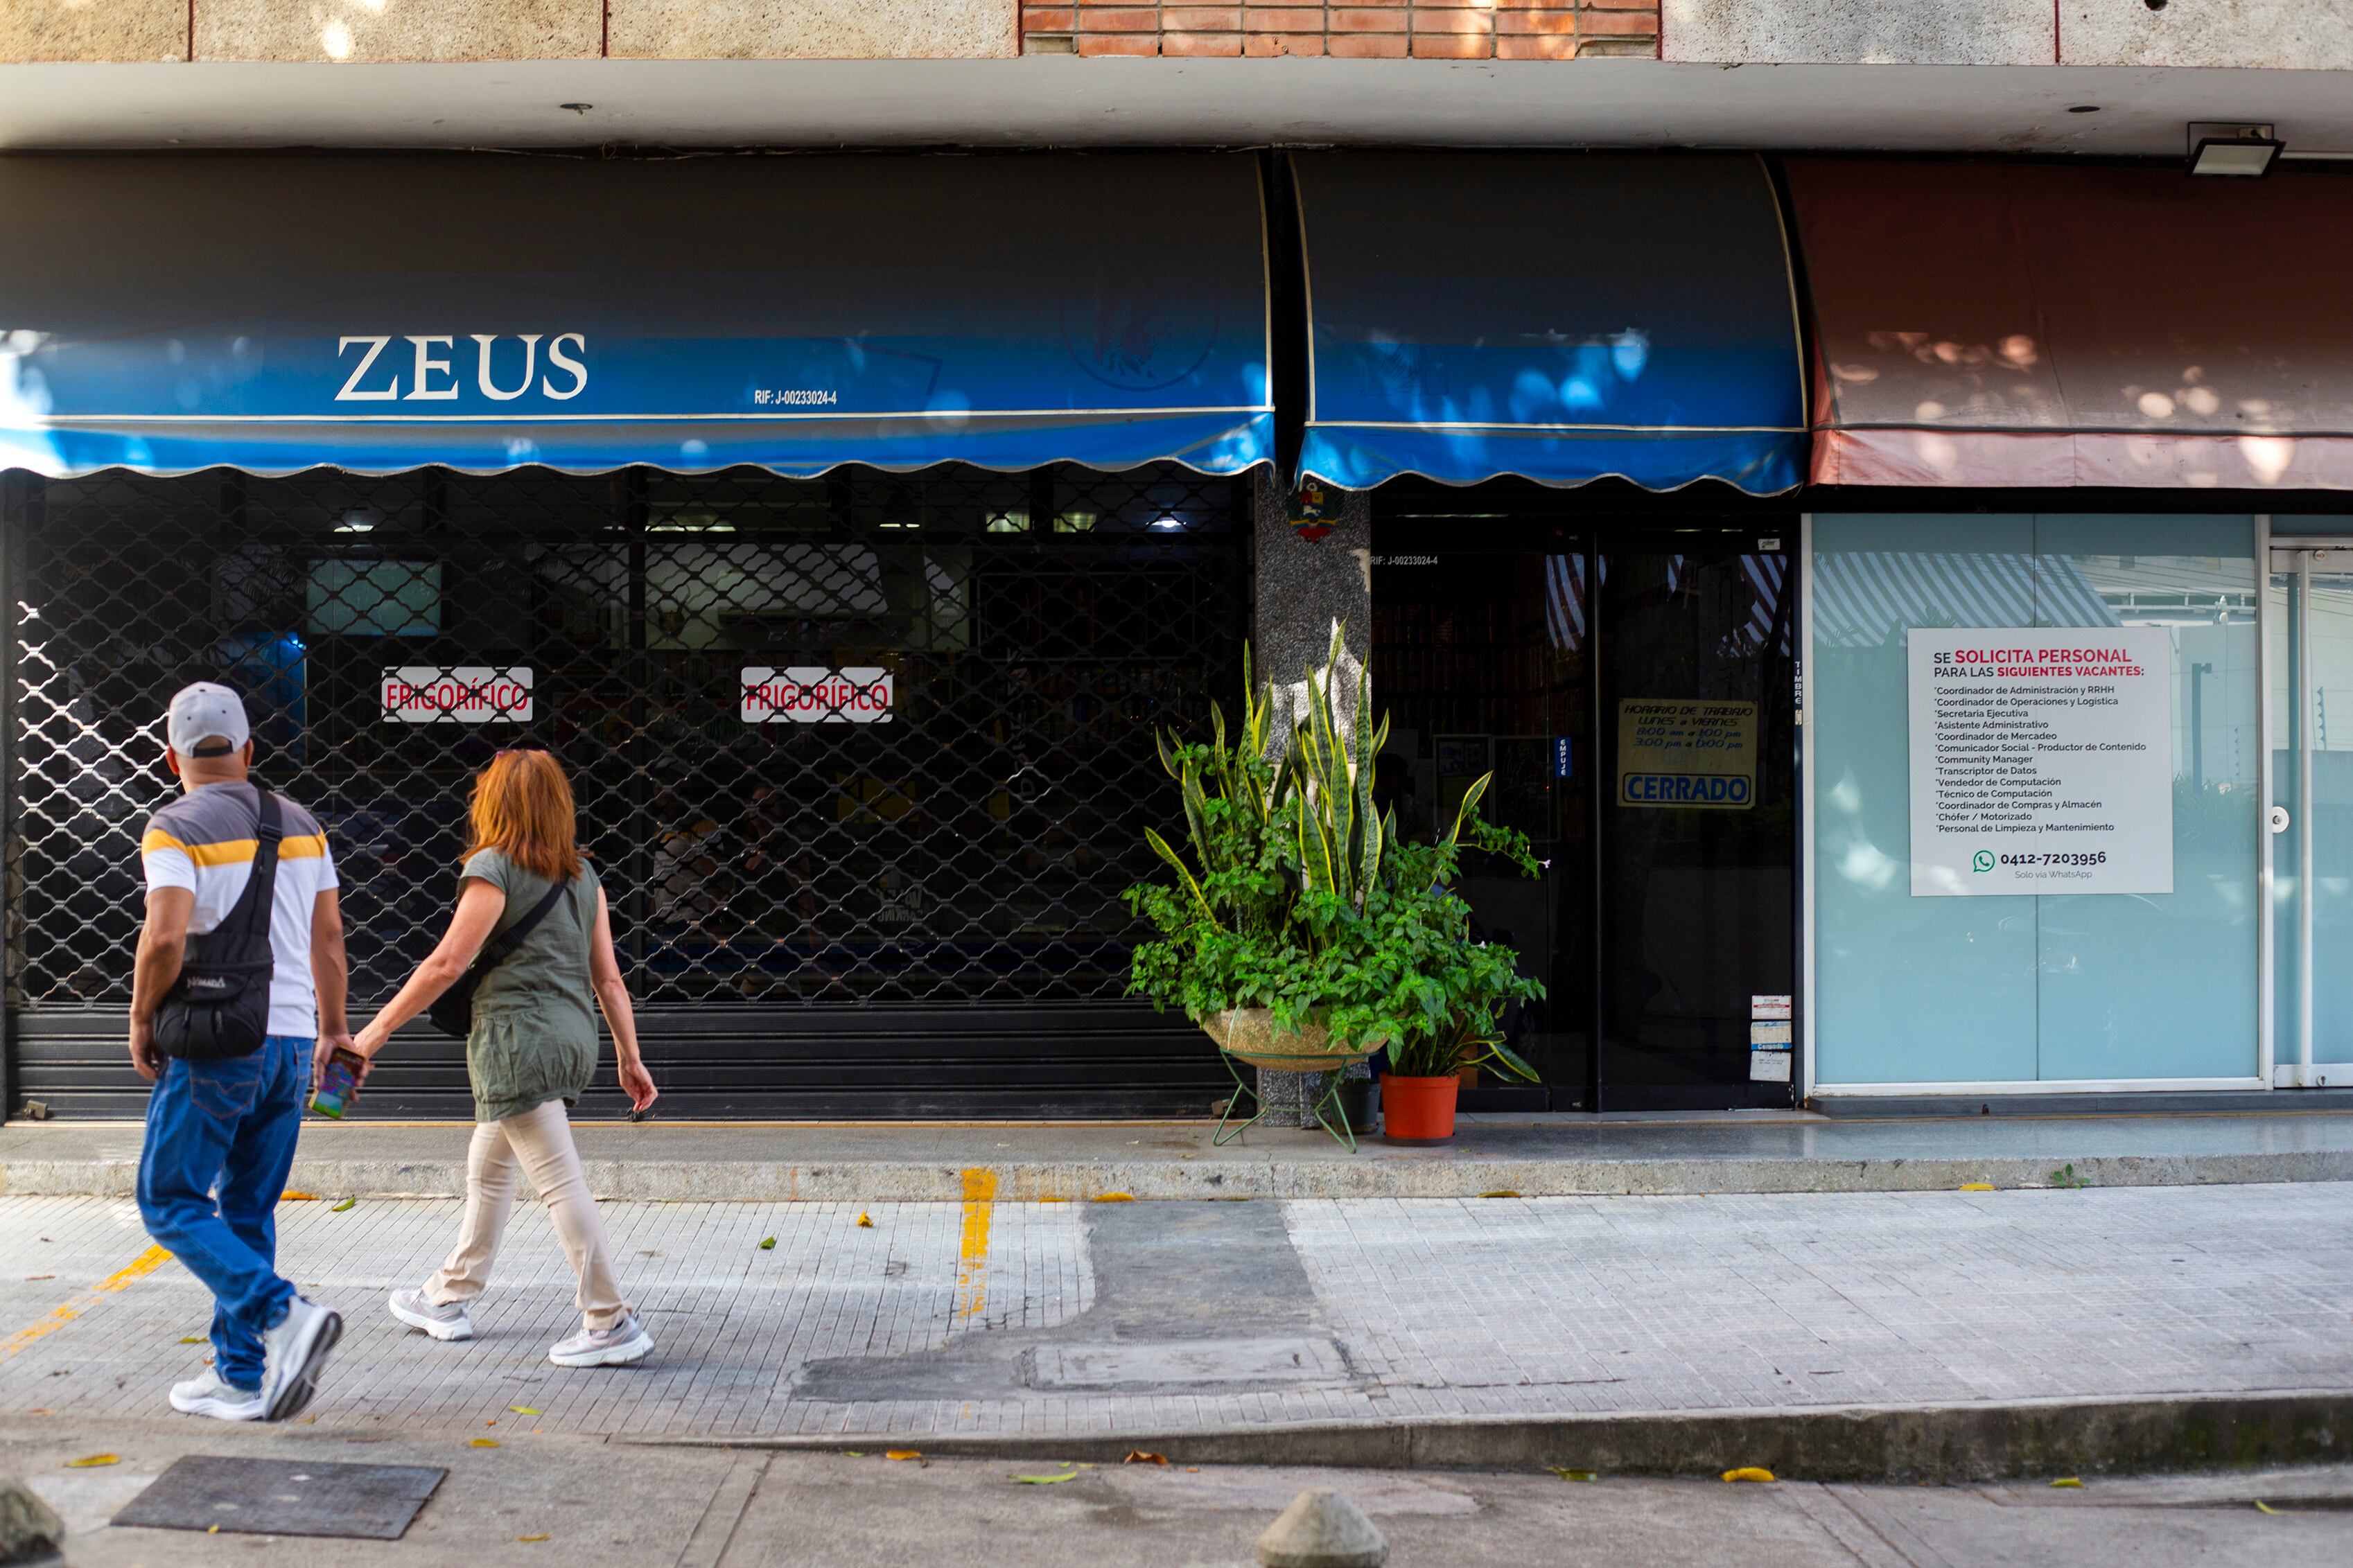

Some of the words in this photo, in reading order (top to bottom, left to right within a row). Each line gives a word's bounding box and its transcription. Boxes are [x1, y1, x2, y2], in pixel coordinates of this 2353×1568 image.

[335, 333, 588, 400] ZEUS
[754, 389, 774, 405] RIF:
[775, 389, 837, 405] J-00233024-4
[1370, 555, 1386, 565] RIF:
[1387, 555, 1439, 565] J-00233024-4
[1934, 653, 1951, 664] SE
[1955, 649, 2034, 663] SOLICITA
[2039, 649, 2132, 662] PERSONAL
[1934, 667, 1967, 678] PARA
[1970, 667, 1994, 677] LAS
[1997, 667, 2072, 677] SIGUIENTES
[2075, 666, 2144, 676] VACANTES:
[387, 677, 528, 710] FRIGORÍFICO
[746, 678, 889, 710] FRIGORÍFICO
[2011, 698, 2068, 707] Operaciones
[2070, 699, 2075, 707] y
[1625, 705, 1677, 714] HORARIO
[1679, 706, 1698, 714] DE
[1703, 707, 1753, 716] TRABAJO
[1987, 710, 2028, 719] Ejecutiva
[1982, 721, 2049, 729] Administrativo
[2011, 732, 2057, 740] Mercadeo
[1559, 739, 1567, 776] EMPUJE
[1993, 755, 2033, 765] Manager
[2000, 777, 2061, 787] Computación
[1628, 776, 1747, 801] CERRADO
[1991, 789, 2052, 799] Computación
[2011, 801, 2053, 811] Compras
[2054, 802, 2060, 811] y
[1995, 824, 2036, 834] Limpieza
[2046, 823, 2114, 831] Mantenimiento
[2001, 852, 2106, 866] 0412-7203956
[2015, 871, 2033, 879] Solo
[2049, 870, 2092, 879] WhatsApp
